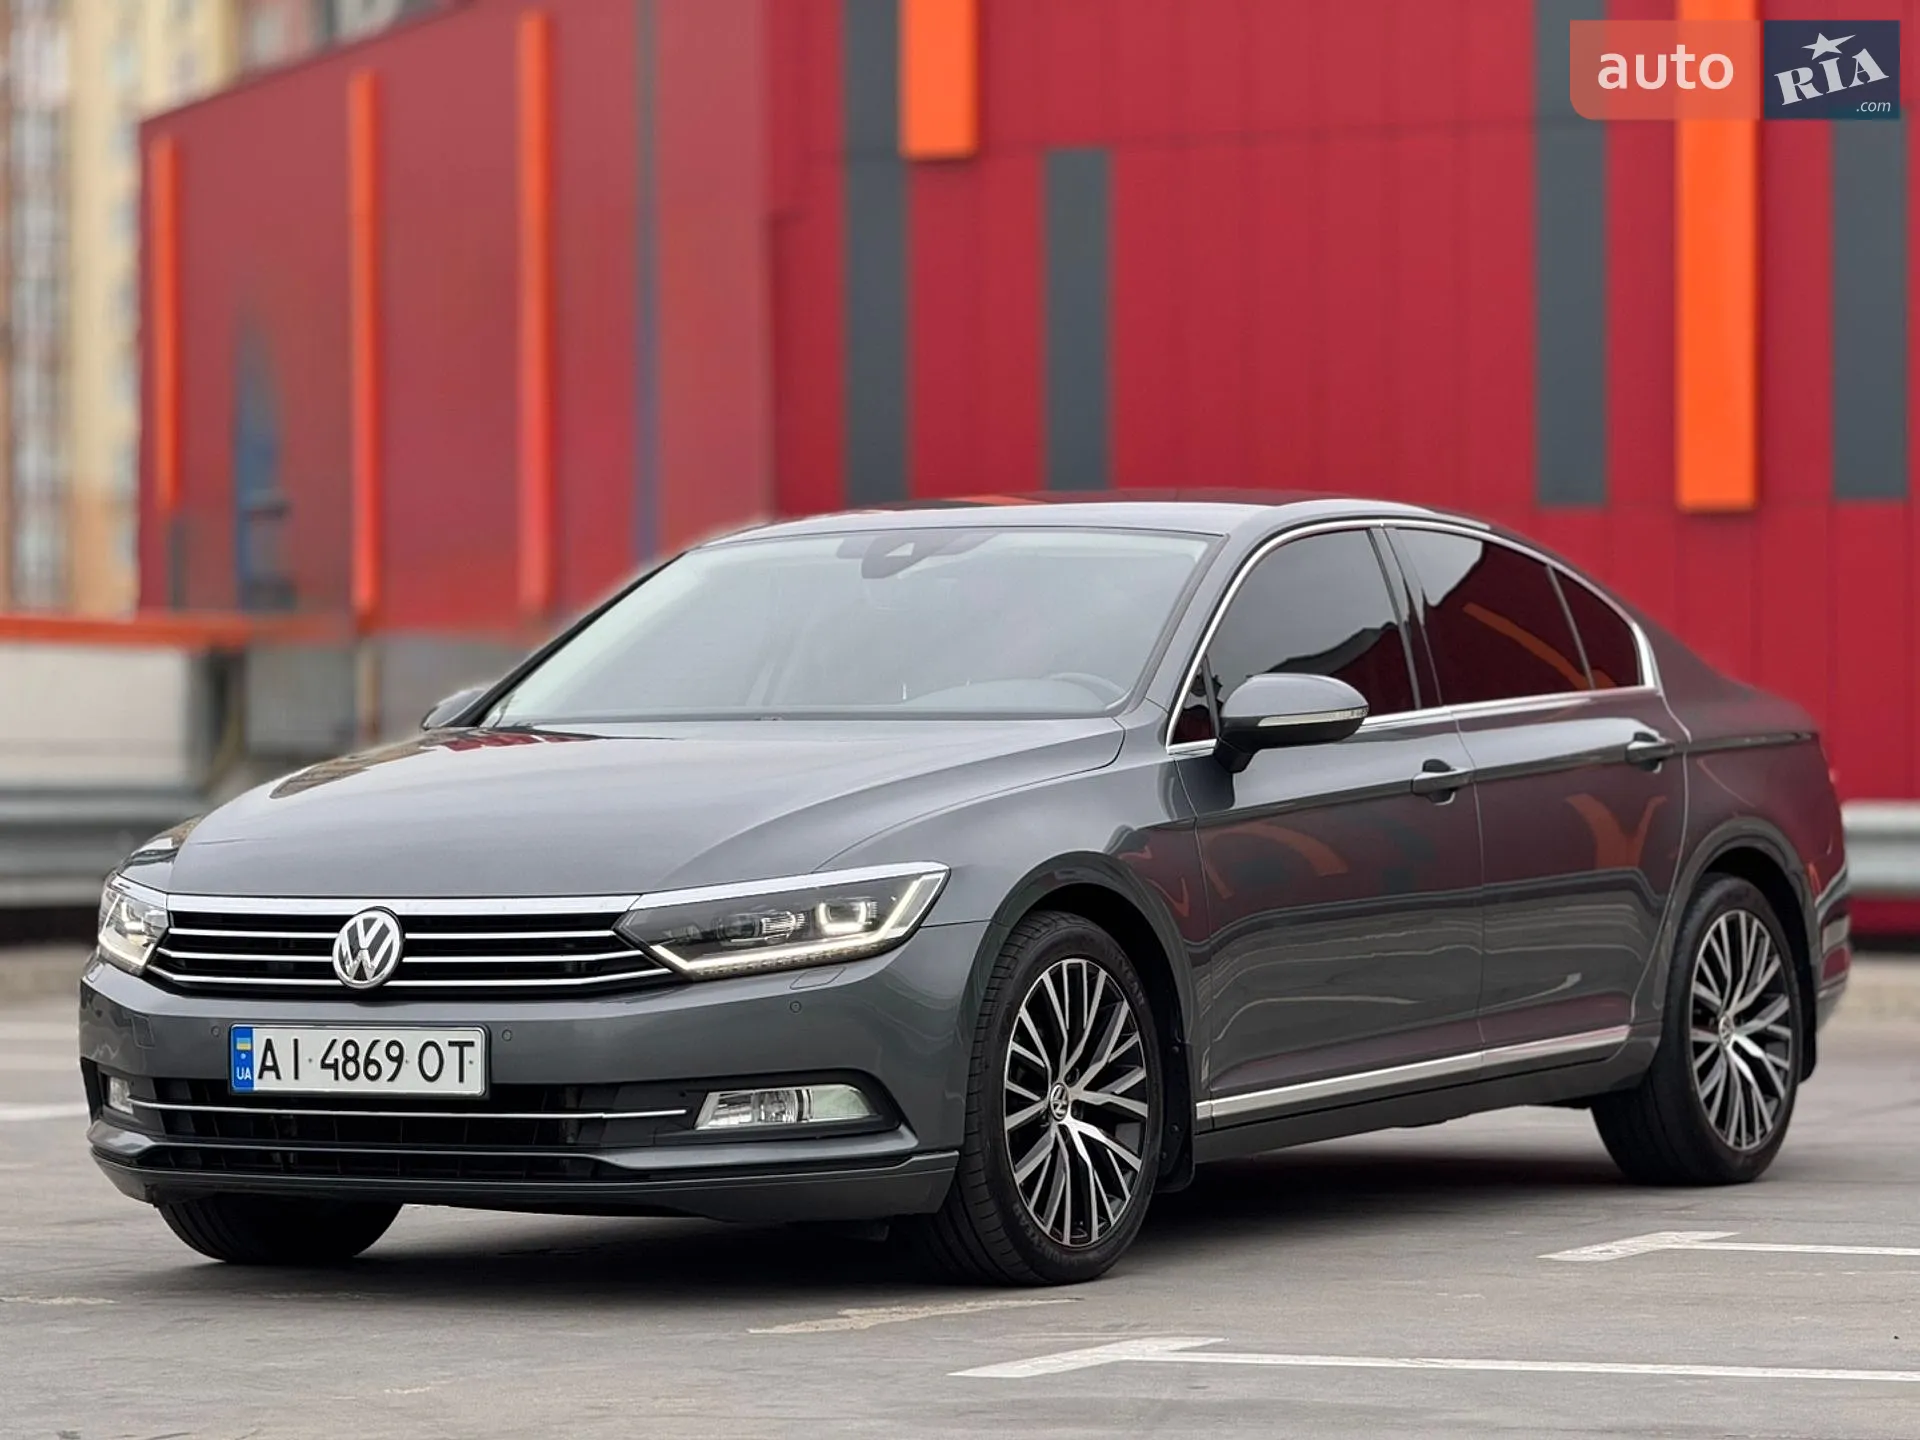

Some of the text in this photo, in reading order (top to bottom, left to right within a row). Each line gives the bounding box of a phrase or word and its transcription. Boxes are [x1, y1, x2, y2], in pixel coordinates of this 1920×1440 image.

[236, 1067, 252, 1081] UA
[257, 1038, 475, 1083] AI 4869 OT
